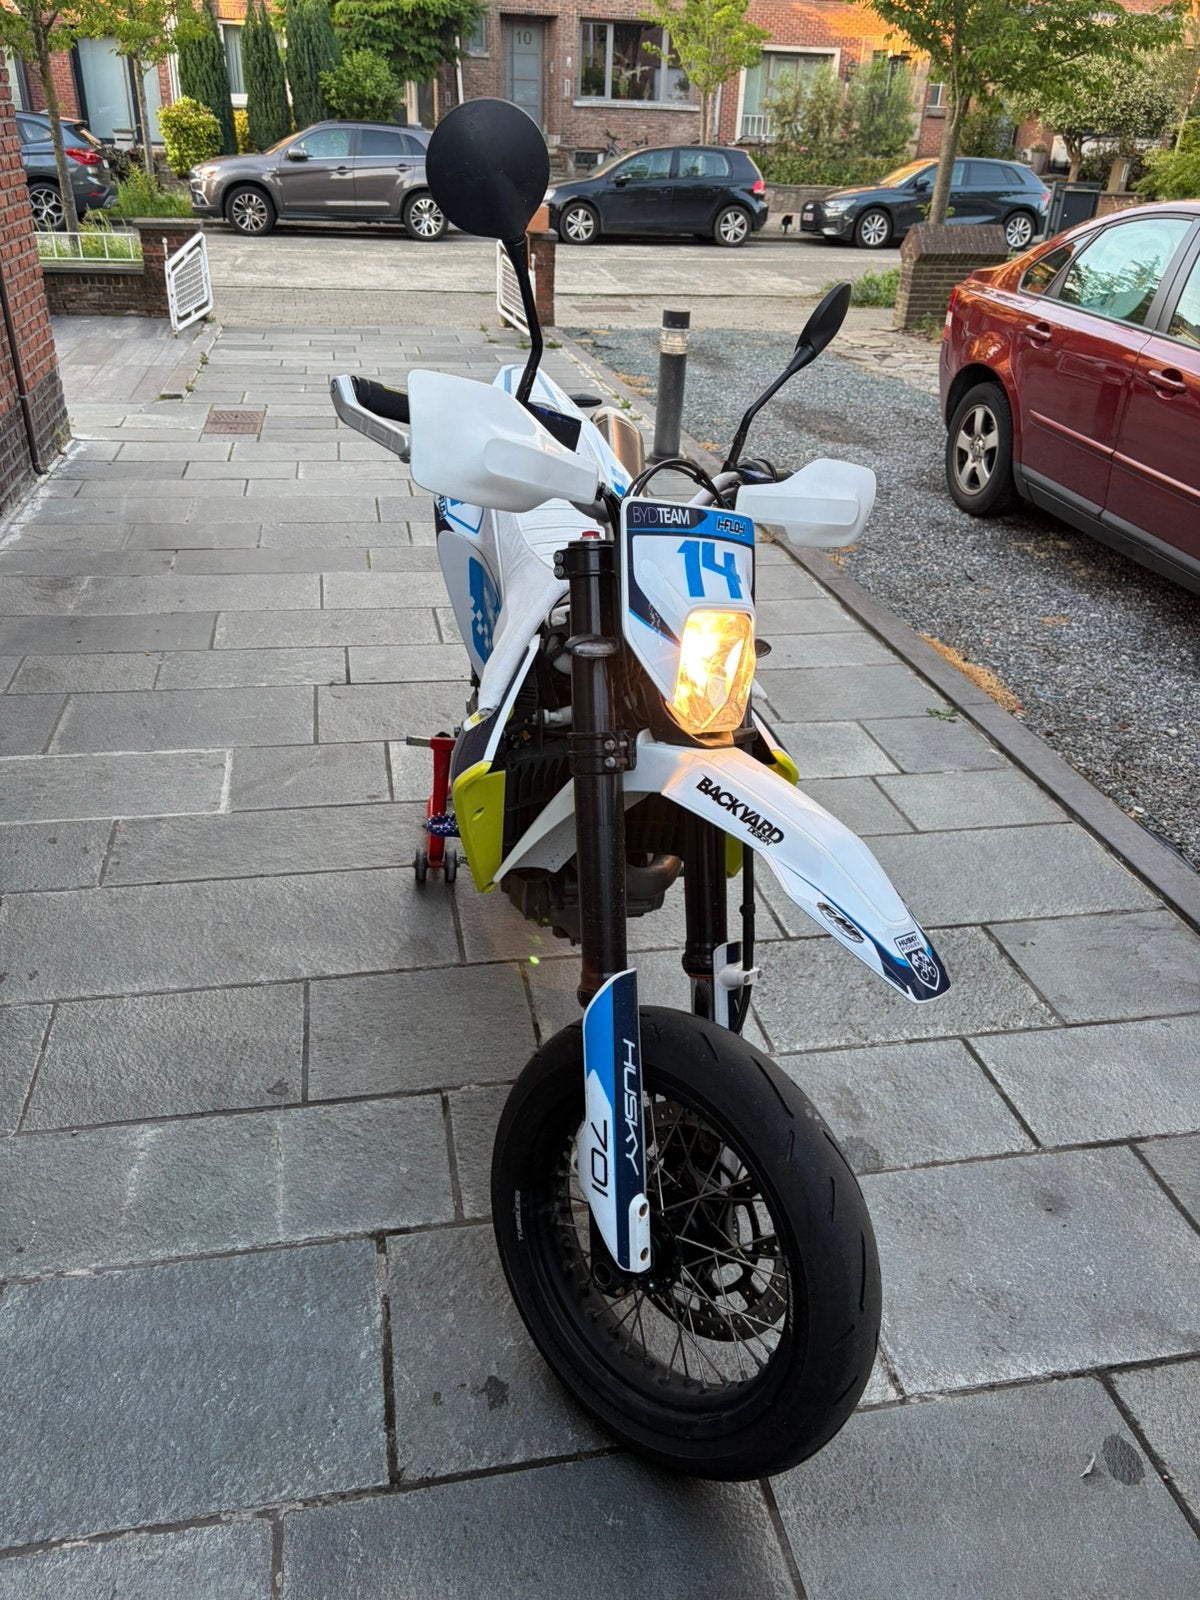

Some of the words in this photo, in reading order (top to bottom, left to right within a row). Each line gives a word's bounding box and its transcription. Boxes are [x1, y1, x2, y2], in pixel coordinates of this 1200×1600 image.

[515, 31, 532, 45] 10
[632, 506, 690, 525] BYDTEAM
[676, 540, 743, 600] 14
[696, 774, 785, 844] BACKYARD
[746, 826, 772, 846] DESIGN
[898, 935, 917, 947] HUSKY
[900, 941, 921, 952] POWER
[622, 1038, 640, 1176] HUSKY
[590, 1119, 609, 1197] 701
